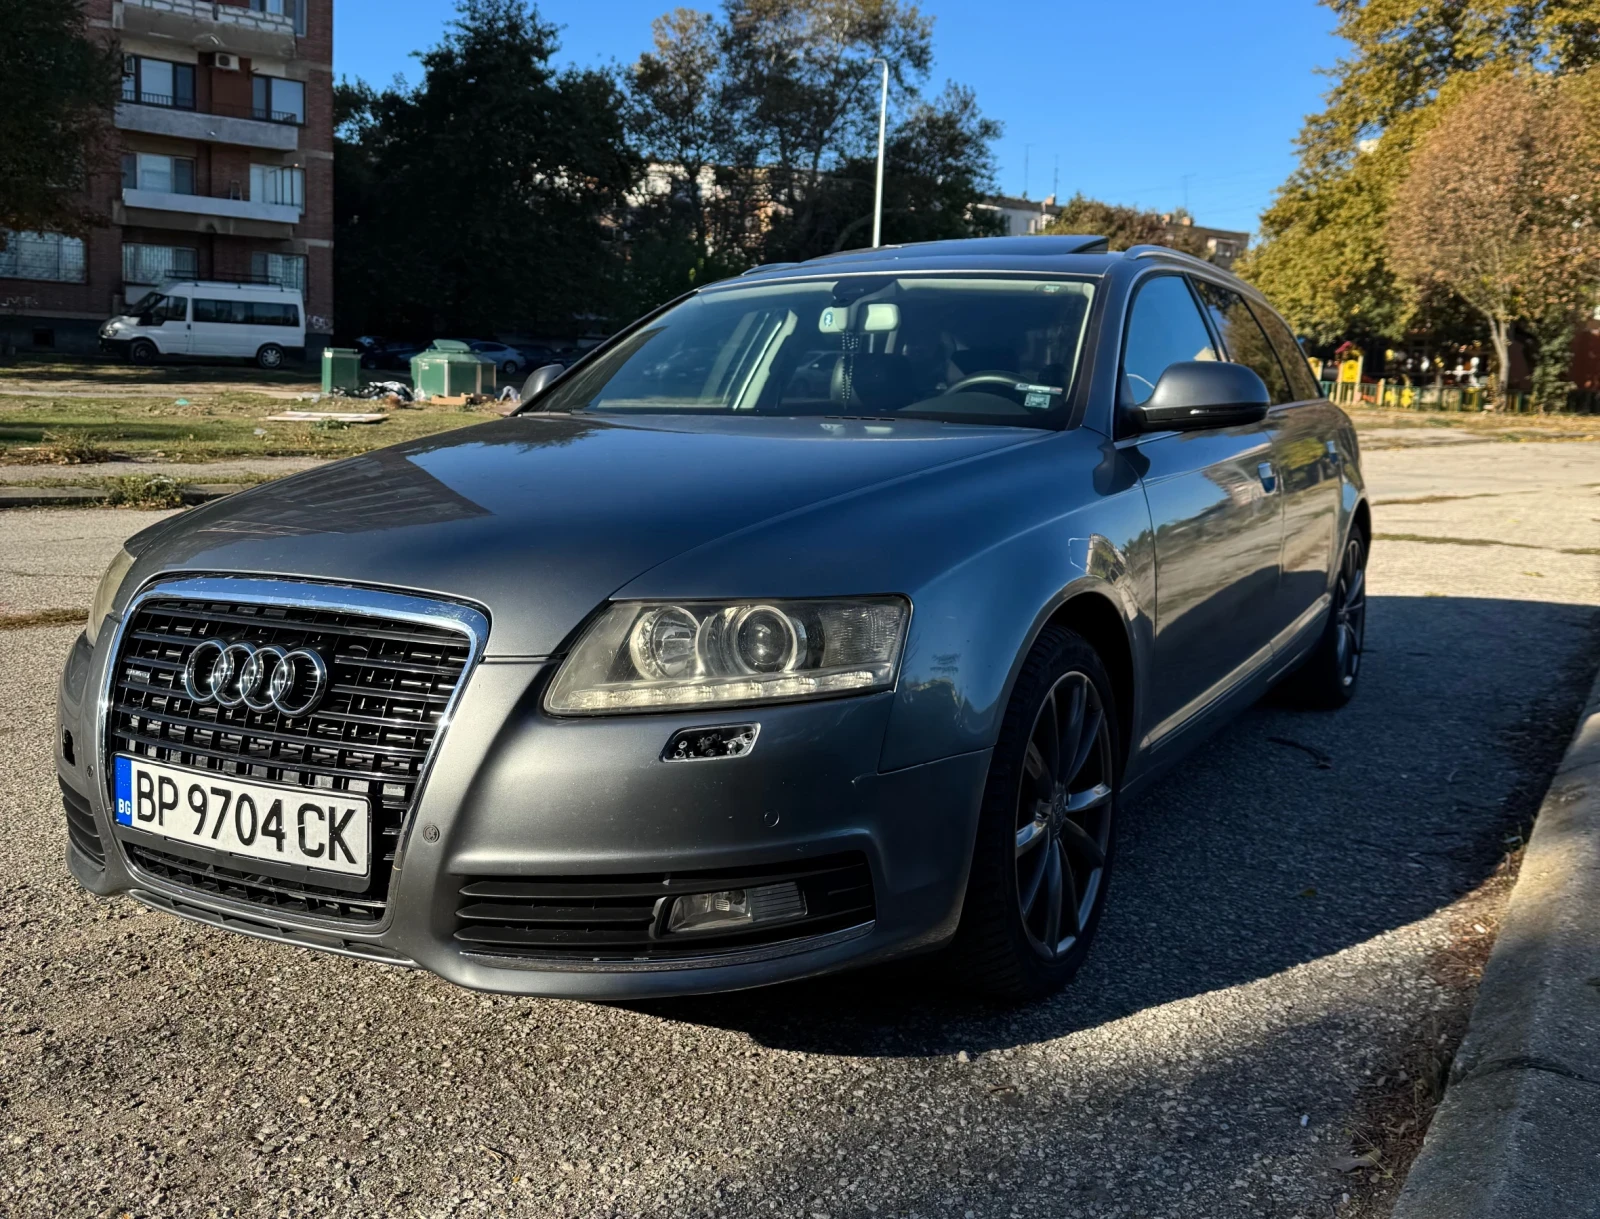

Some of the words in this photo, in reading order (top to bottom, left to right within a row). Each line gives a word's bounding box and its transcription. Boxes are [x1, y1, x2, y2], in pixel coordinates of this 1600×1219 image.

[118, 798, 131, 816] BG
[136, 769, 179, 826] BP
[187, 783, 286, 853] 9704
[298, 802, 357, 865] CK
